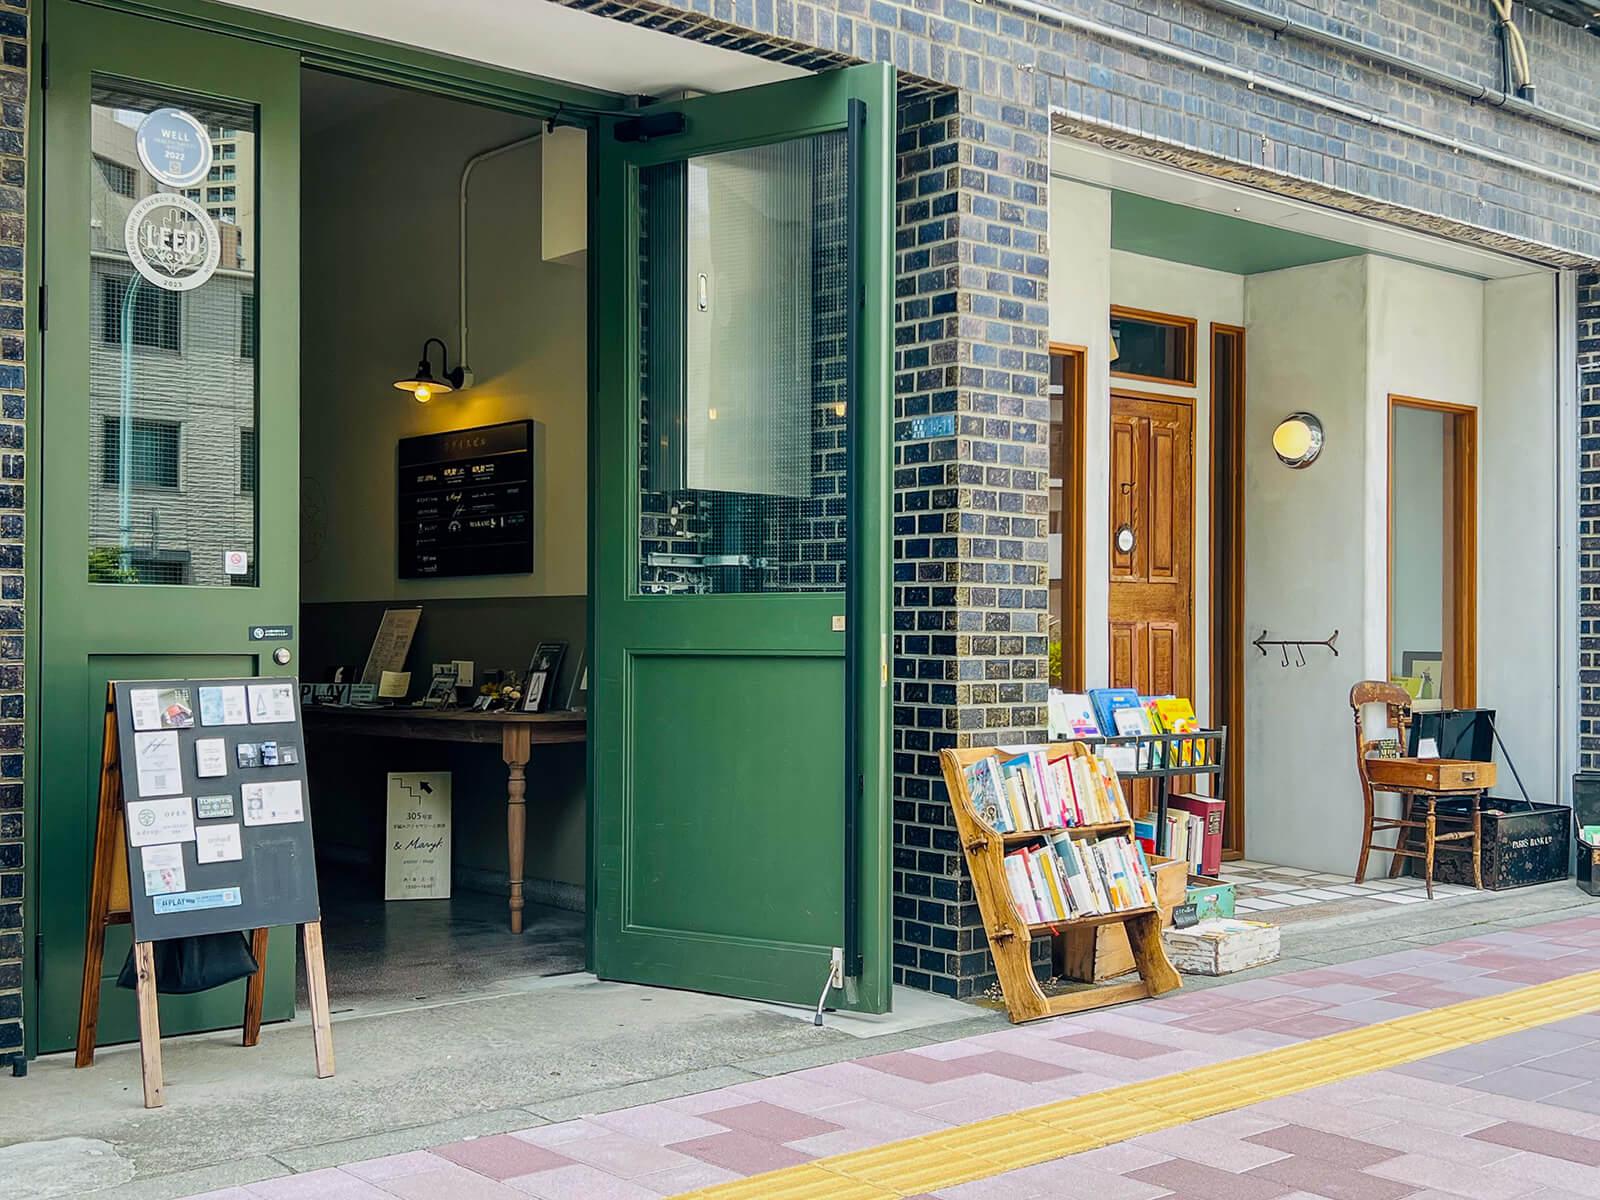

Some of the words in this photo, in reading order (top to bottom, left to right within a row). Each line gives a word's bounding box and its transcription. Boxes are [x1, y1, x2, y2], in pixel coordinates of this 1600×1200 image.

[161, 129, 190, 141] WELL
[164, 150, 185, 161] 2022
[146, 225, 200, 256] LEED
